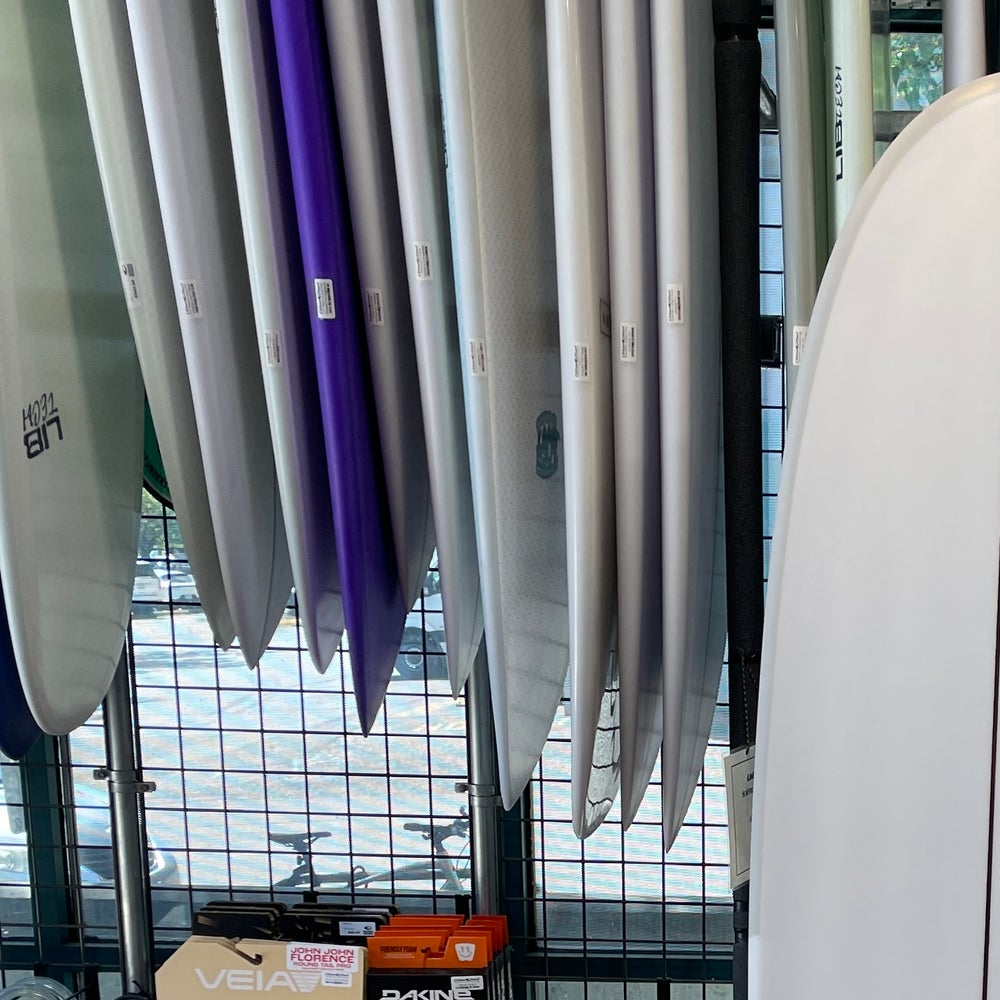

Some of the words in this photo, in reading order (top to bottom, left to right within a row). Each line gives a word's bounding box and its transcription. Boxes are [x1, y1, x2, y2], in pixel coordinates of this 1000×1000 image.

[23, 415, 63, 459] LIB
[291, 947, 321, 955] JOHN
[324, 948, 354, 956] JOHN
[290, 953, 355, 964] FLORENCE
[379, 989, 475, 1000] DAKINE
